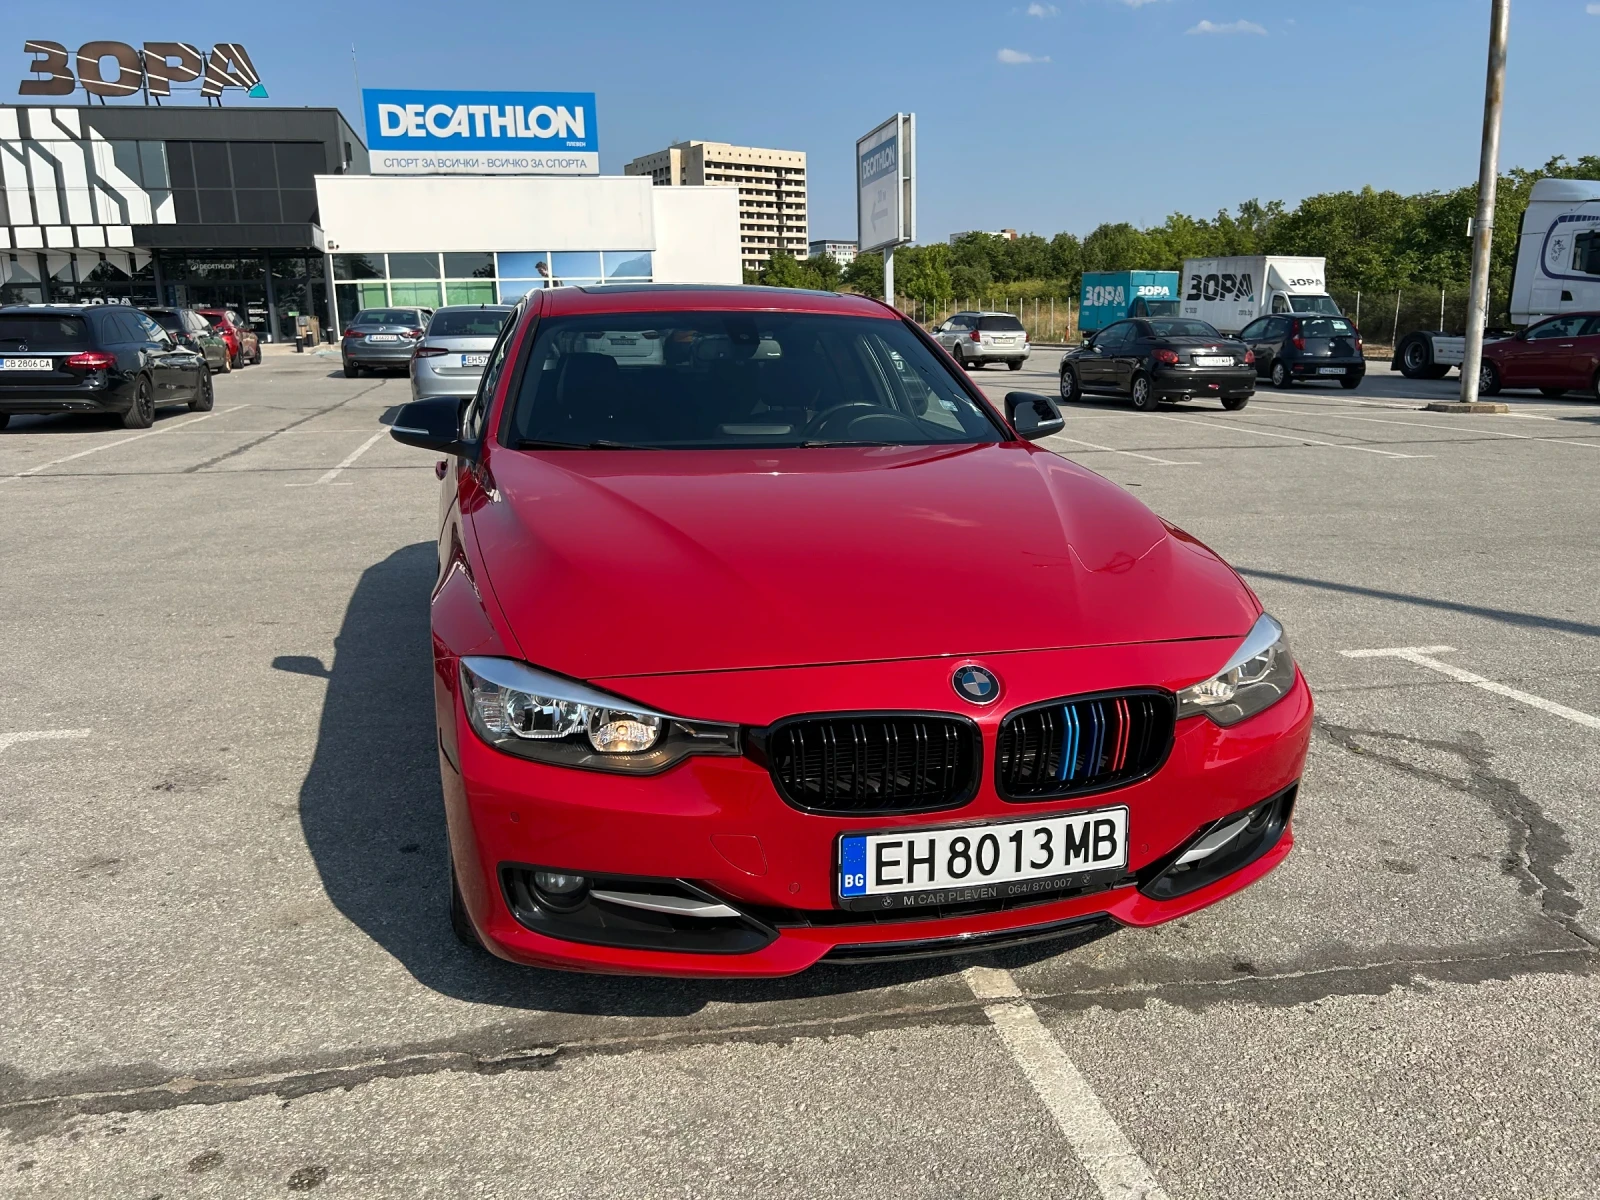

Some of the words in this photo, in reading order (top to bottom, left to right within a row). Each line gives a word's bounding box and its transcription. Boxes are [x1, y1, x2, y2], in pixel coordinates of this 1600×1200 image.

[18, 40, 269, 98] ЗОРА
[378, 104, 586, 139] DECATHLON
[384, 158, 419, 168] СПОРТ
[421, 158, 435, 168] ЗА
[438, 159, 479, 168] ВСИЧКИ
[487, 159, 529, 168] ВСИЧКО
[531, 159, 544, 168] ЗА
[547, 159, 587, 168] СПОРТА
[863, 145, 895, 180] DECATHLON
[1137, 286, 1170, 296] ЗОРА
[1186, 273, 1255, 302] ЗОРА
[1288, 278, 1324, 286] ЗОРА
[1083, 286, 1125, 306] ЗОРА
[5, 360, 16, 368] CB
[18, 360, 38, 368] 2806
[40, 360, 50, 368] CA
[955, 666, 990, 679] BMW
[875, 839, 936, 886] EH
[947, 827, 1054, 879] 8013
[1064, 818, 1117, 866] MB
[845, 874, 864, 888] BG
[903, 896, 914, 905] M
[918, 892, 945, 904] CAR
[948, 887, 997, 901] PLEVEN
[1033, 880, 1052, 891] 870
[1054, 878, 1073, 888] 007
